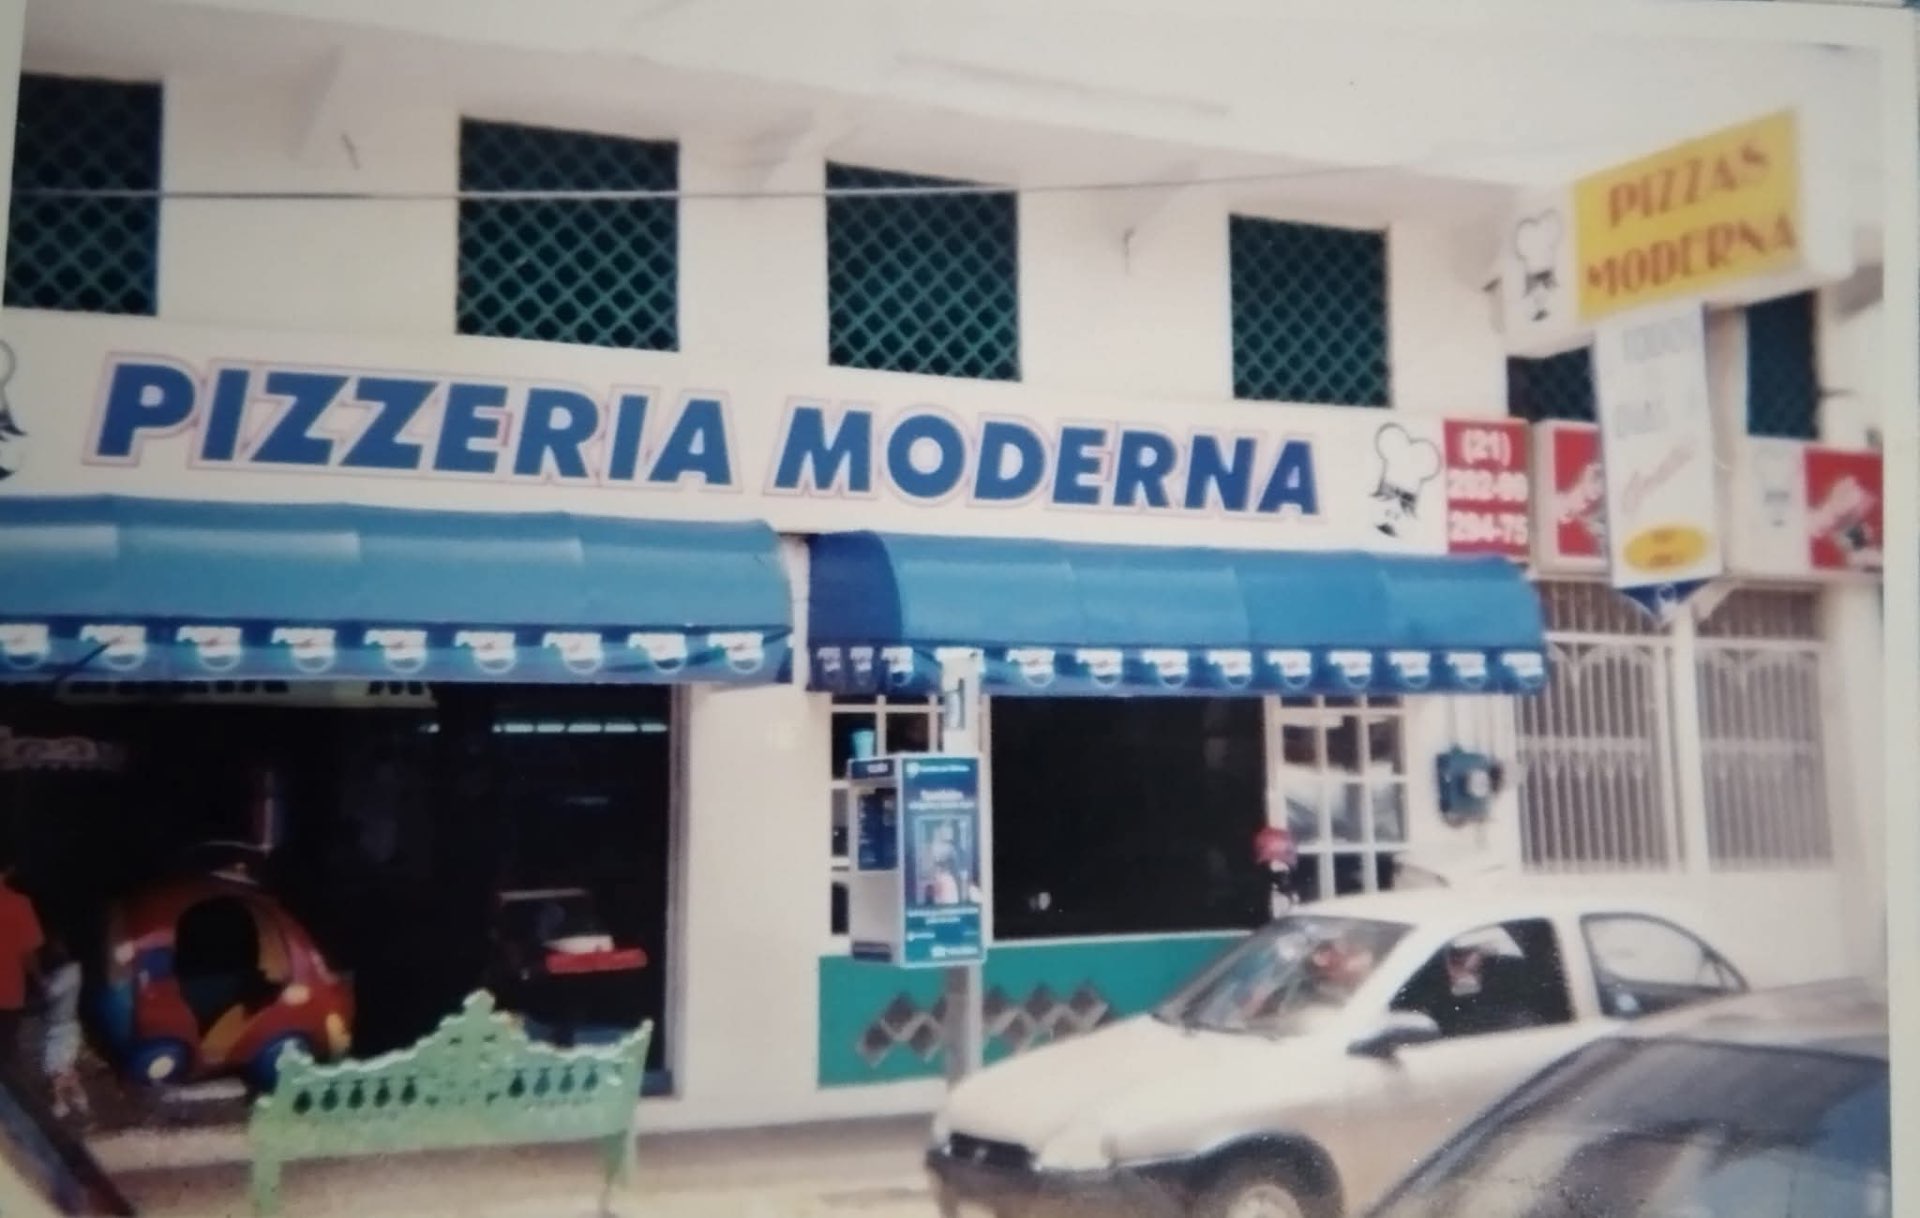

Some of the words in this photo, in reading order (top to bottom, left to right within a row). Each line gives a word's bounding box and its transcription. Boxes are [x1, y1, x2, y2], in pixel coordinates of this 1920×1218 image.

[1607, 138, 1770, 228] PIZZAS
[1586, 208, 1798, 297] MODERNA
[97, 363, 732, 486] PIZZERIA
[773, 406, 1321, 515] MODERNA
